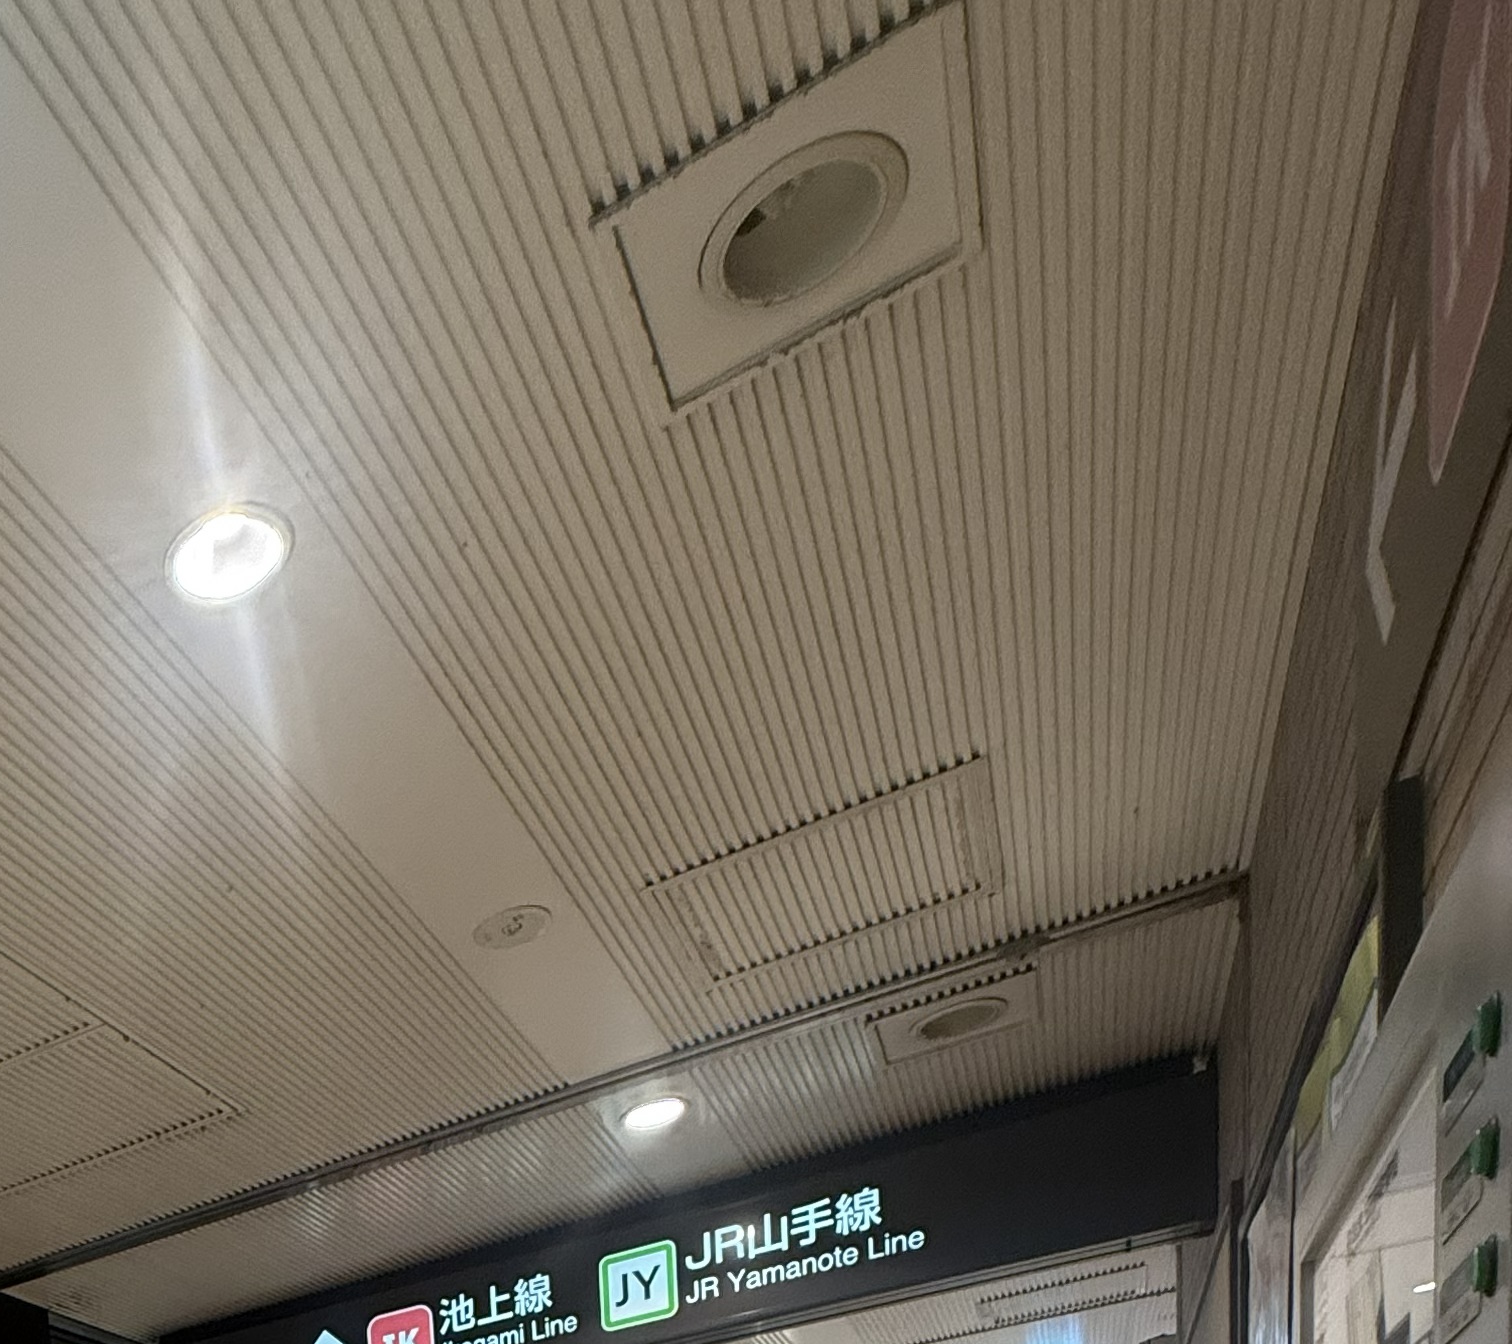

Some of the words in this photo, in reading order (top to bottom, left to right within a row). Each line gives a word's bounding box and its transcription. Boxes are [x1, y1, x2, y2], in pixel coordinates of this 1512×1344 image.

[685, 1187, 883, 1271] JR山手線
[614, 1265, 662, 1308] JY
[685, 1278, 720, 1304] JR
[726, 1245, 859, 1294] Yamanote
[868, 1228, 926, 1259] Line
[439, 1274, 553, 1336] 池上線
[531, 1313, 578, 1341] Line
